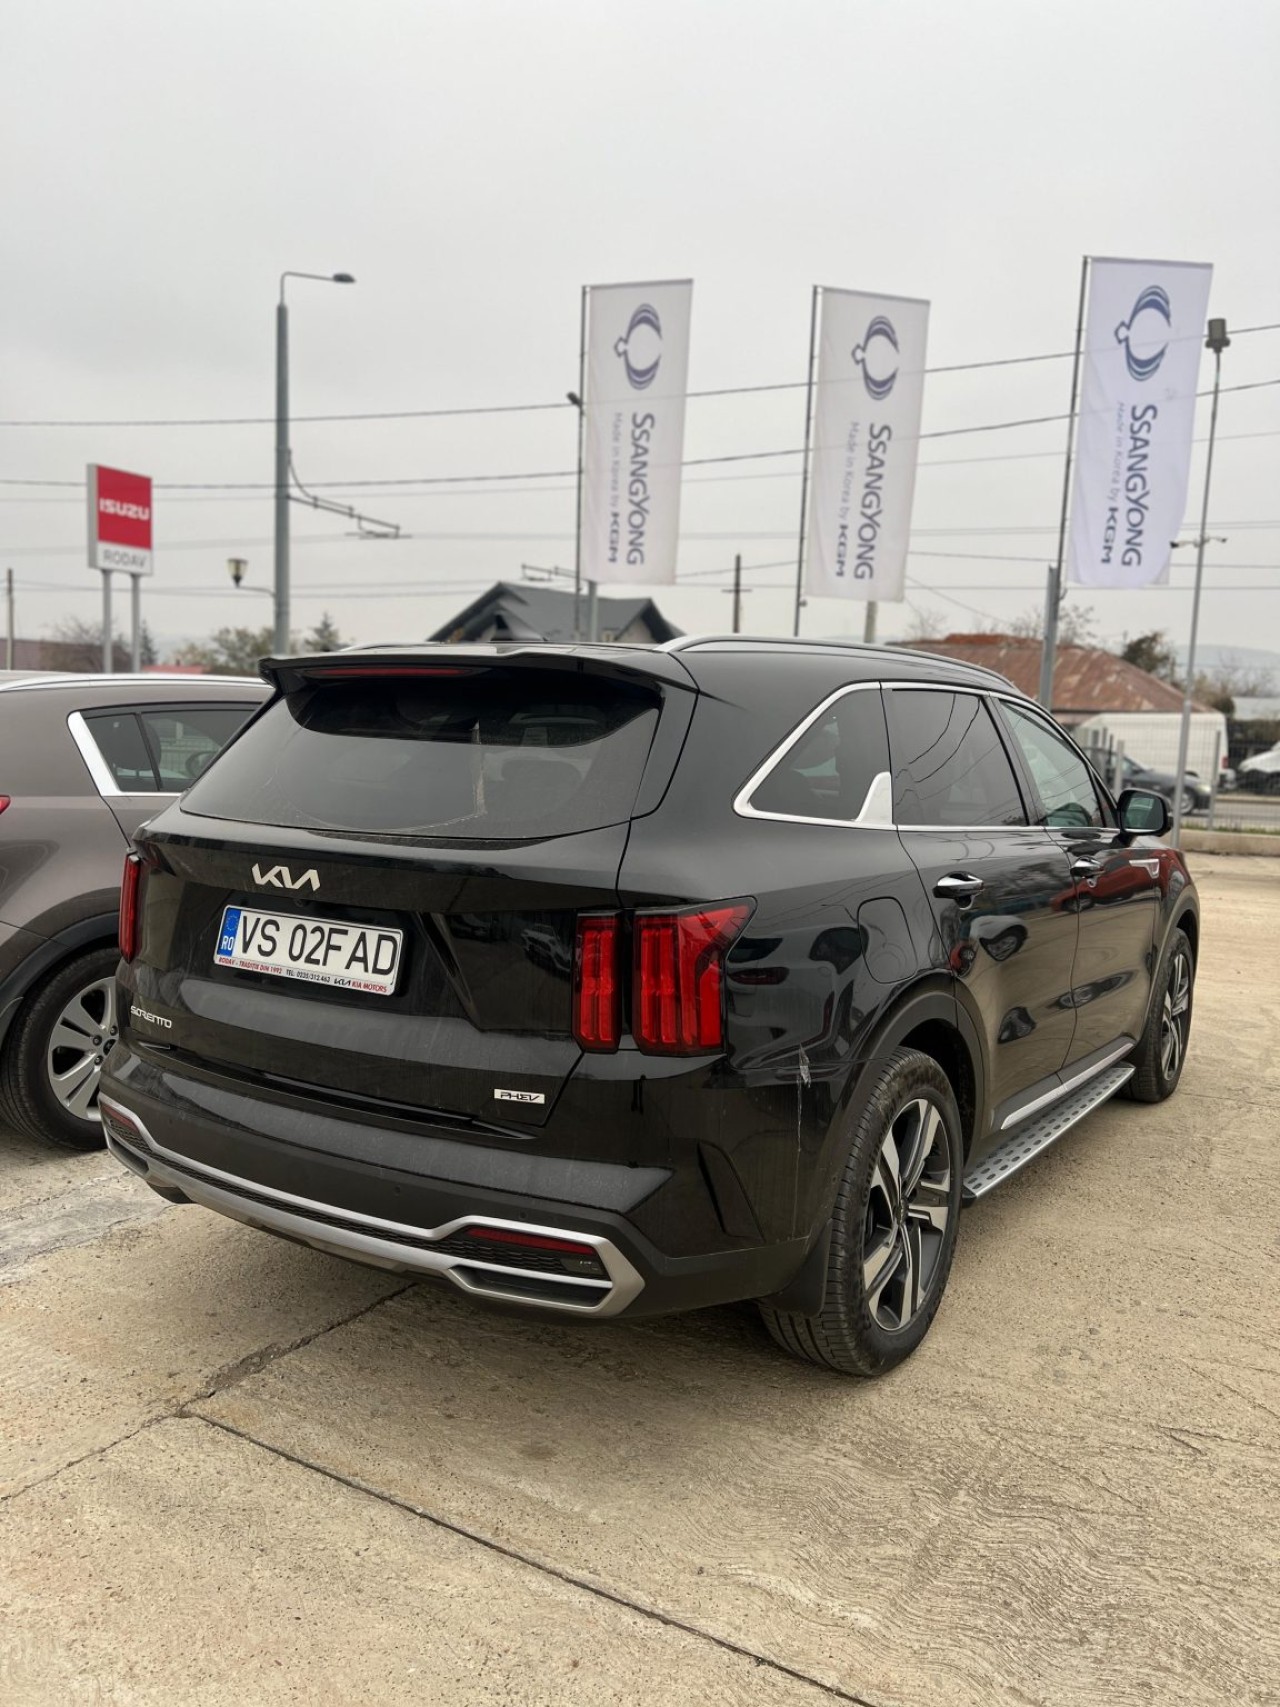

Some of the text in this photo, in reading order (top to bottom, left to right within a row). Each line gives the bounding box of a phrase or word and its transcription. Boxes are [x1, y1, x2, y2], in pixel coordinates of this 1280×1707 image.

[626, 412, 656, 565] SSANGYONG
[1121, 404, 1158, 567] SSANGYONG
[99, 498, 150, 521] ISUZU
[854, 423, 892, 580] SSANGYONG
[252, 862, 321, 892] KIA
[220, 935, 235, 950] RO
[241, 915, 399, 976] VS 02FAD
[130, 1005, 173, 1029] SORENTO
[500, 1090, 540, 1102] PHEV
